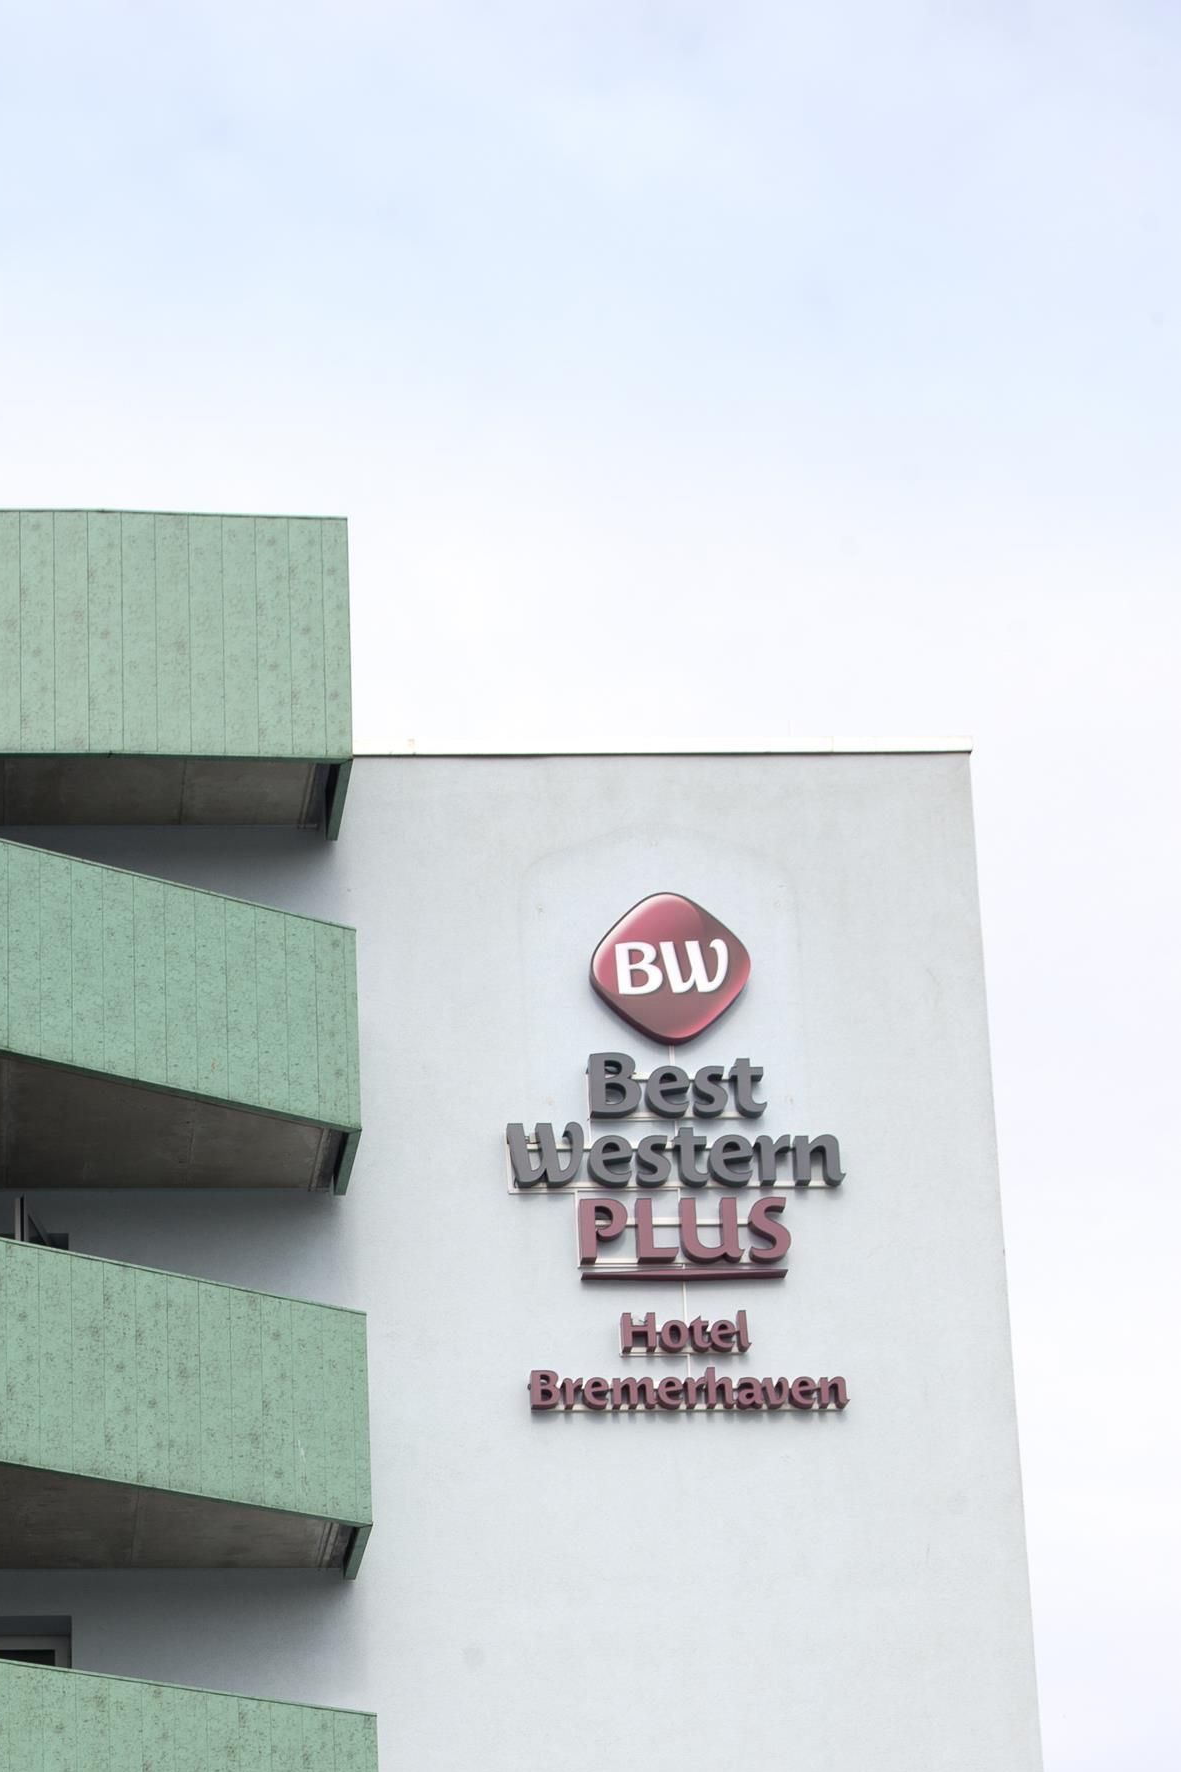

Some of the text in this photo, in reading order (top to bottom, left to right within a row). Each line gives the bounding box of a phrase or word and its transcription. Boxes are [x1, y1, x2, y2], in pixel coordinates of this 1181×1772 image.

[614, 937, 730, 996] BW
[588, 1052, 768, 1119] Best
[506, 1121, 846, 1188] Western
[578, 1196, 793, 1266] PLUS
[619, 1310, 752, 1355] Hotel
[528, 1367, 850, 1411] Bremerhaven
